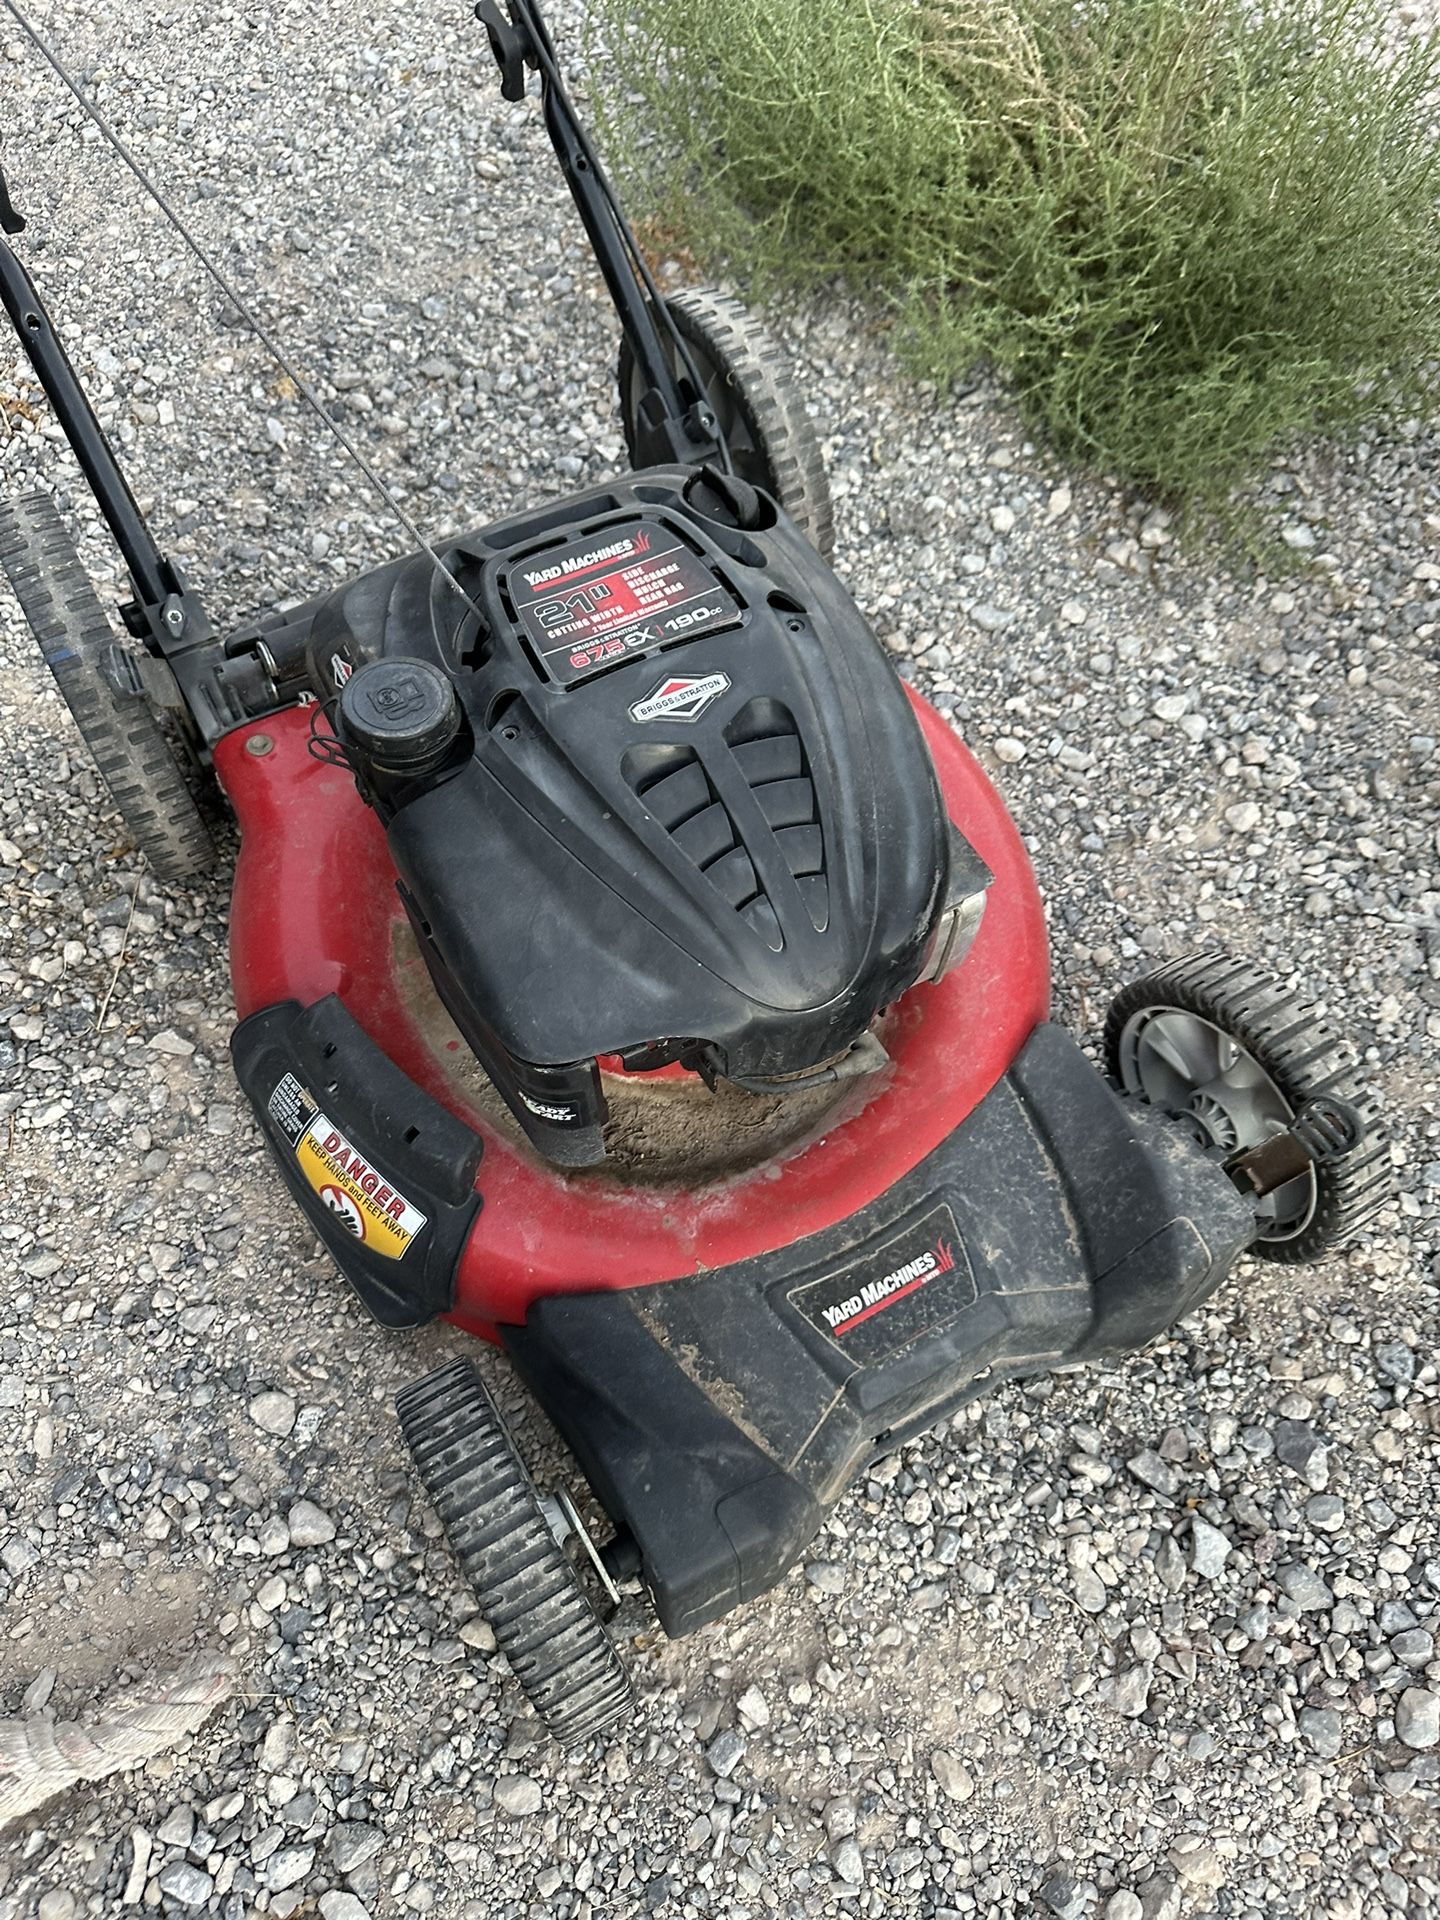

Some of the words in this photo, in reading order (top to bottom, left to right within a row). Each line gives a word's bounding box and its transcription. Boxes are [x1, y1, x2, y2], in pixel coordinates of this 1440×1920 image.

[524, 566, 562, 587] YARD
[561, 539, 634, 573] MACHINES
[621, 566, 645, 581] SIDE
[626, 562, 680, 589] DISCHARGE
[633, 579, 667, 597] MULCH
[638, 590, 665, 605] REAR
[664, 582, 684, 596] BAG
[547, 616, 591, 639] CUTTING
[590, 605, 624, 625] WIDTH
[598, 621, 613, 631] Year
[612, 612, 638, 628] Limited
[637, 600, 669, 619] Warranty
[307, 1137, 326, 1160] KEEP
[323, 1157, 350, 1187] HANDS
[348, 1186, 363, 1201] and
[362, 1198, 385, 1219] FEET
[382, 1217, 408, 1241] AWAY
[323, 1131, 406, 1220] DANGER
[821, 1295, 863, 1328] YARD
[860, 1252, 937, 1306] MACHINES
